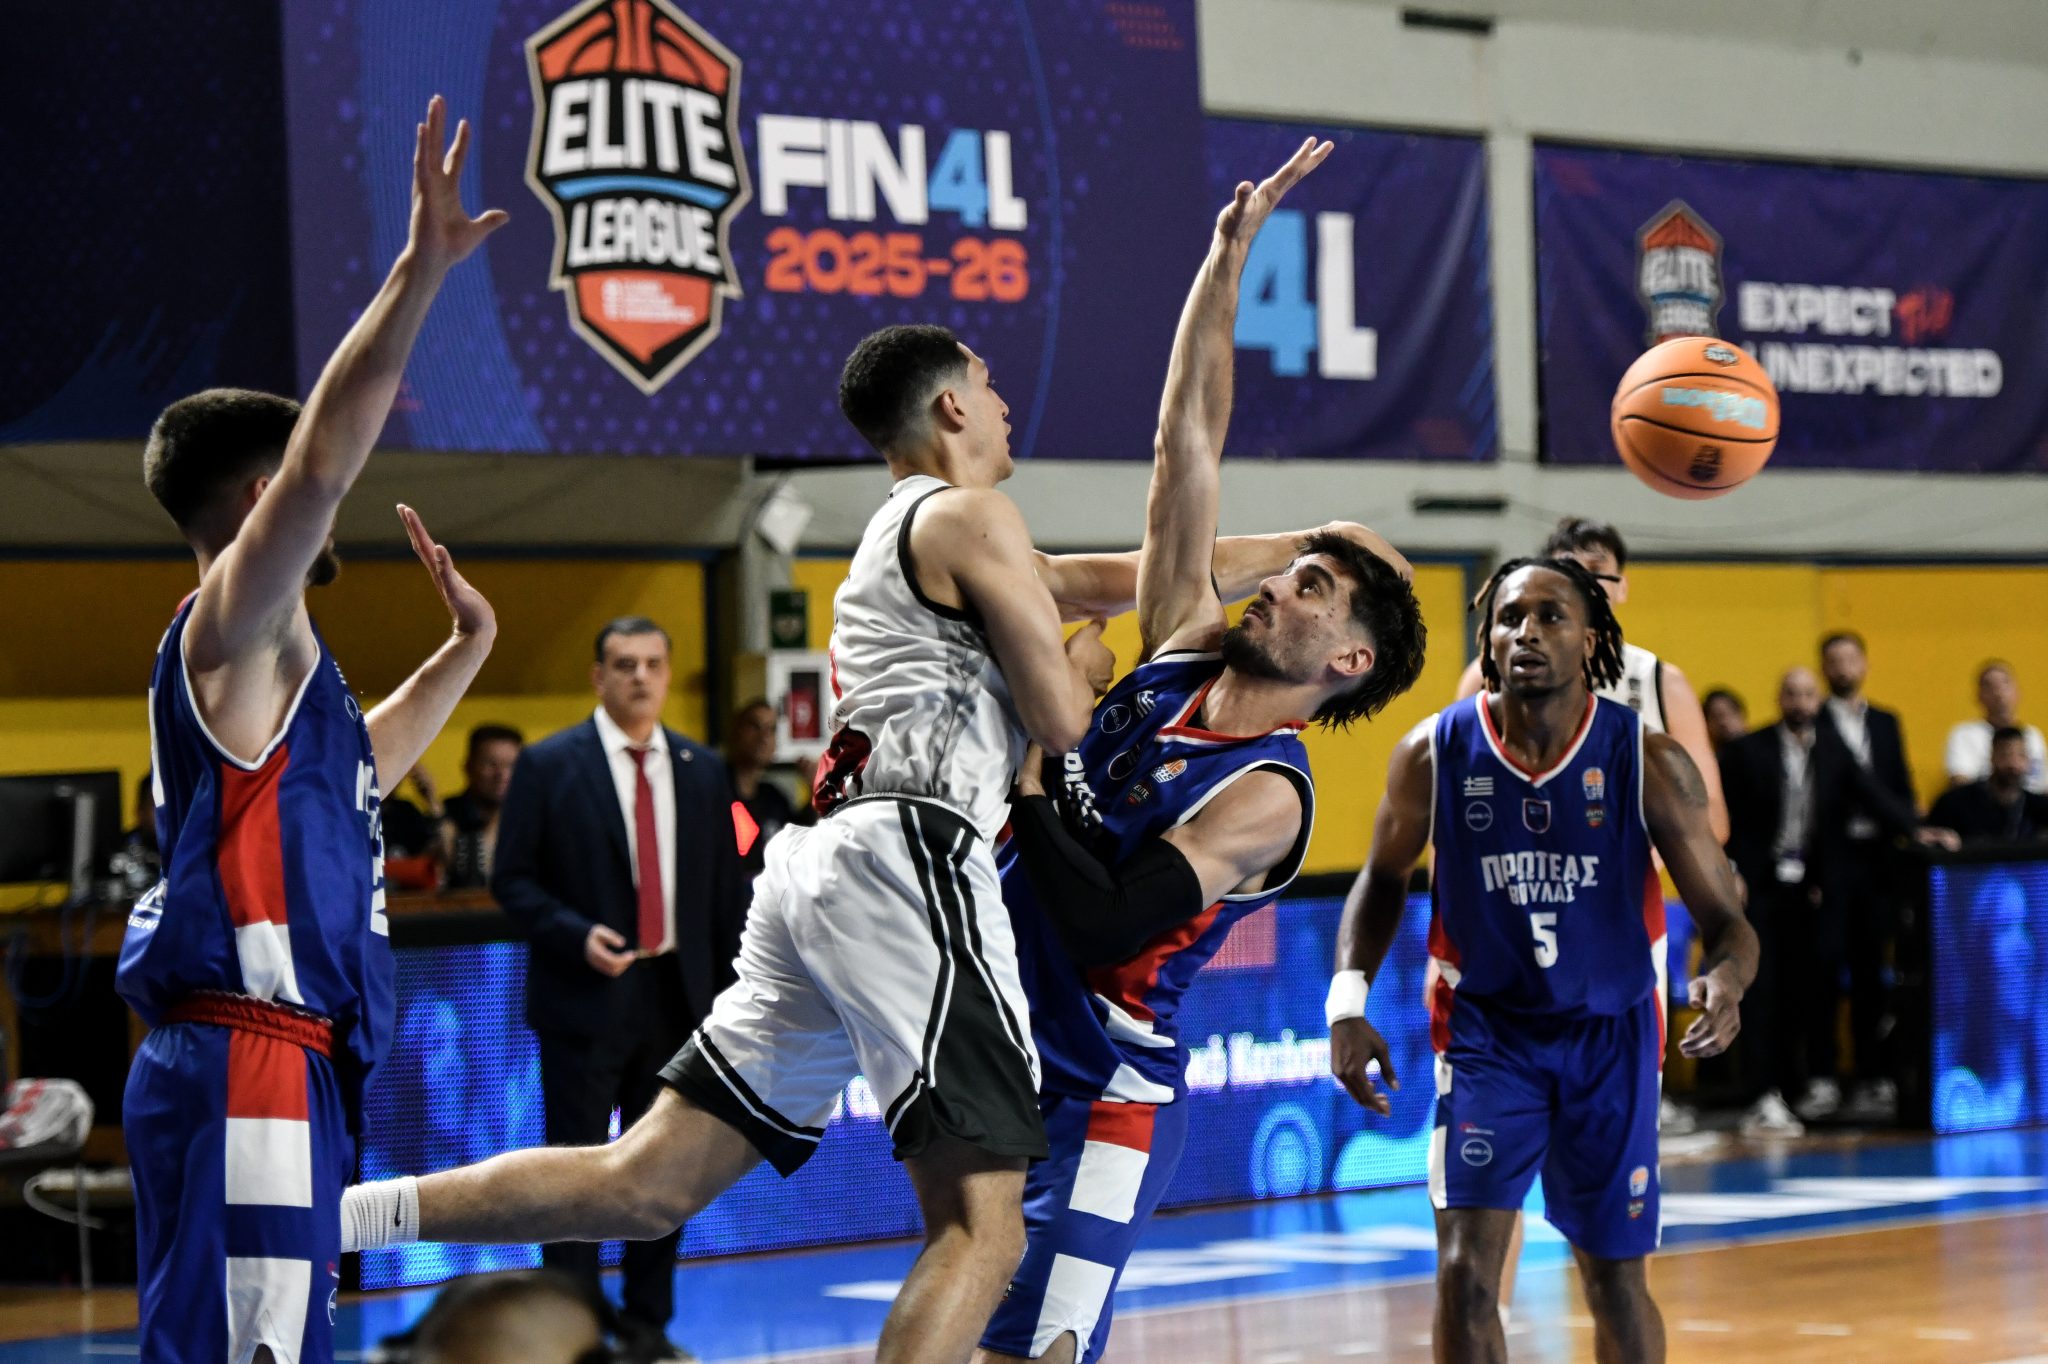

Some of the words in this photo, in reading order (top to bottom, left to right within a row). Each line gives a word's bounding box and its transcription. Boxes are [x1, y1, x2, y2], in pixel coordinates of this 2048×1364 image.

[542, 77, 737, 189] ELITE
[756, 112, 1029, 231] FIN4L
[567, 197, 724, 276] LEAGUE
[764, 226, 1031, 303] 2025-26
[1738, 281, 1897, 338] EXPECT
[1480, 851, 1600, 893] ΠΡΩΤΕΑΣ
[1508, 881, 1576, 906] ΒΟΥΛΑΣ
[1529, 912, 1559, 969] 5
